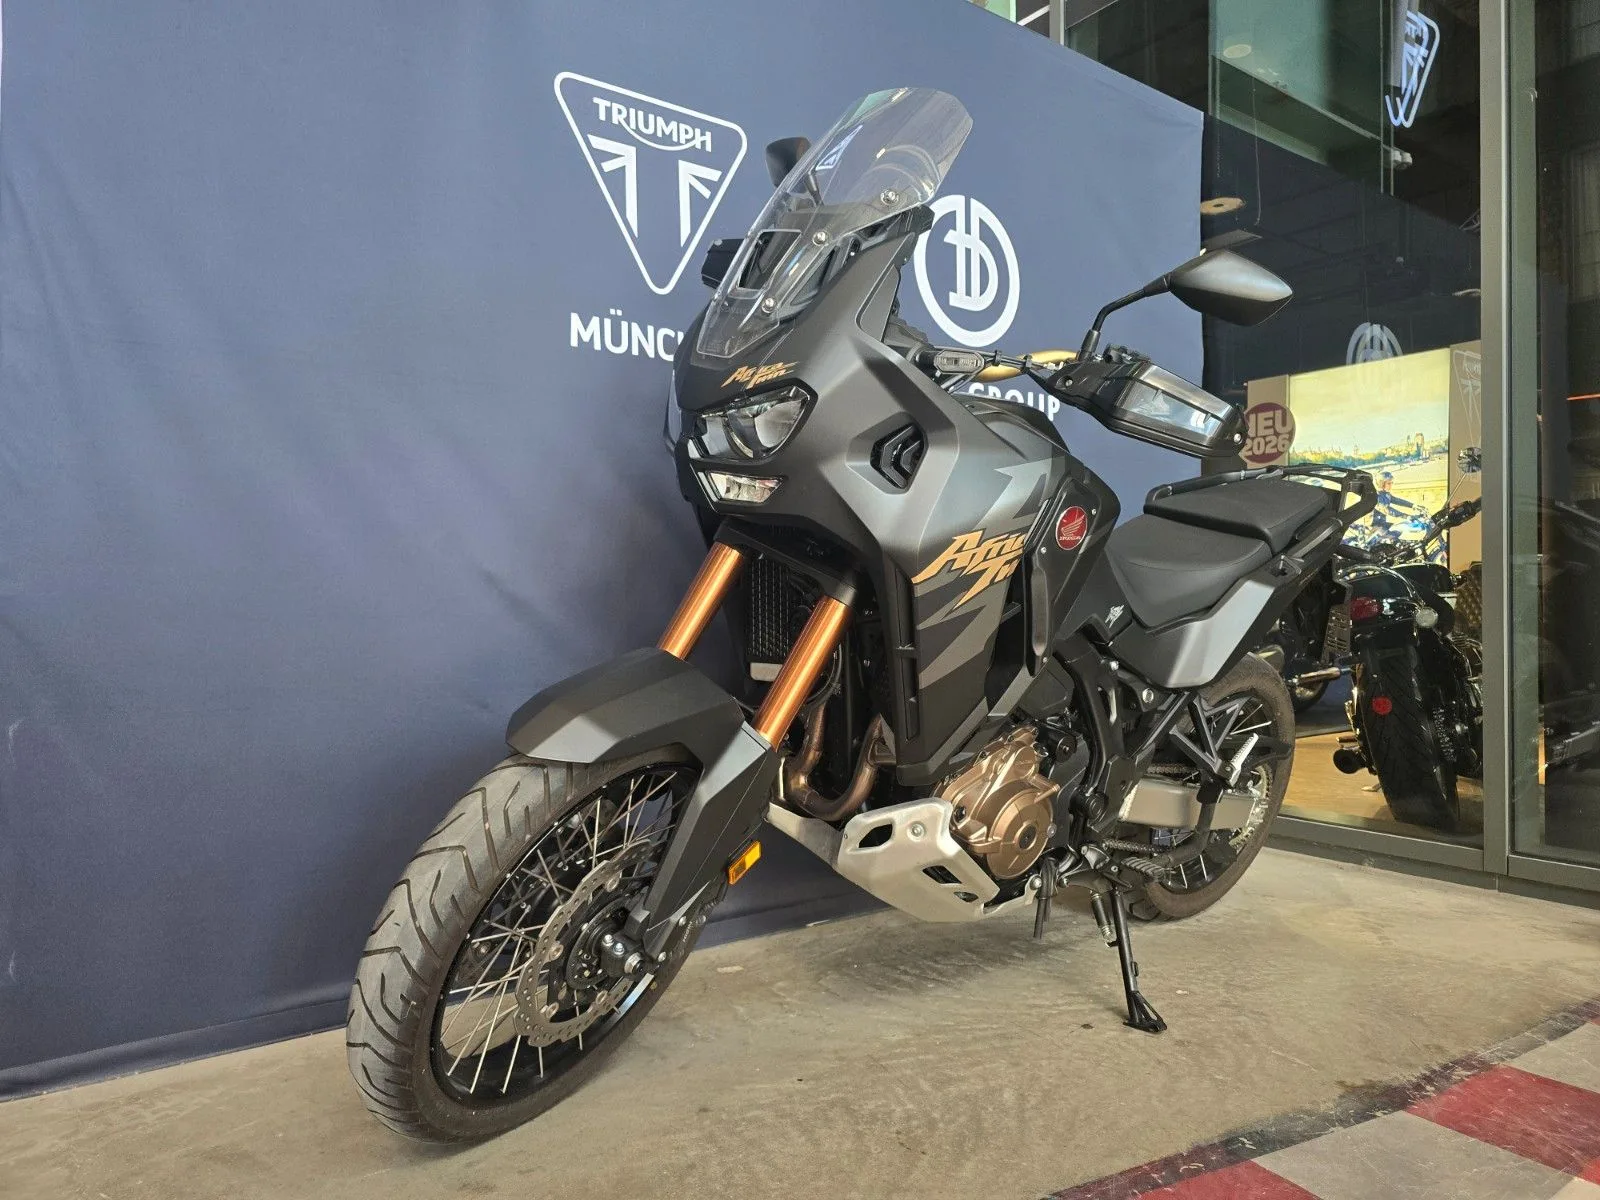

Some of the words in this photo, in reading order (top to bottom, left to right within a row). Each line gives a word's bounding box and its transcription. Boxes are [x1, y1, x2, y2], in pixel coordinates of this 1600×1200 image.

[593, 97, 711, 152] TRIUMPH
[570, 308, 684, 361] MÜNC
[1244, 434, 1290, 455] 2026
